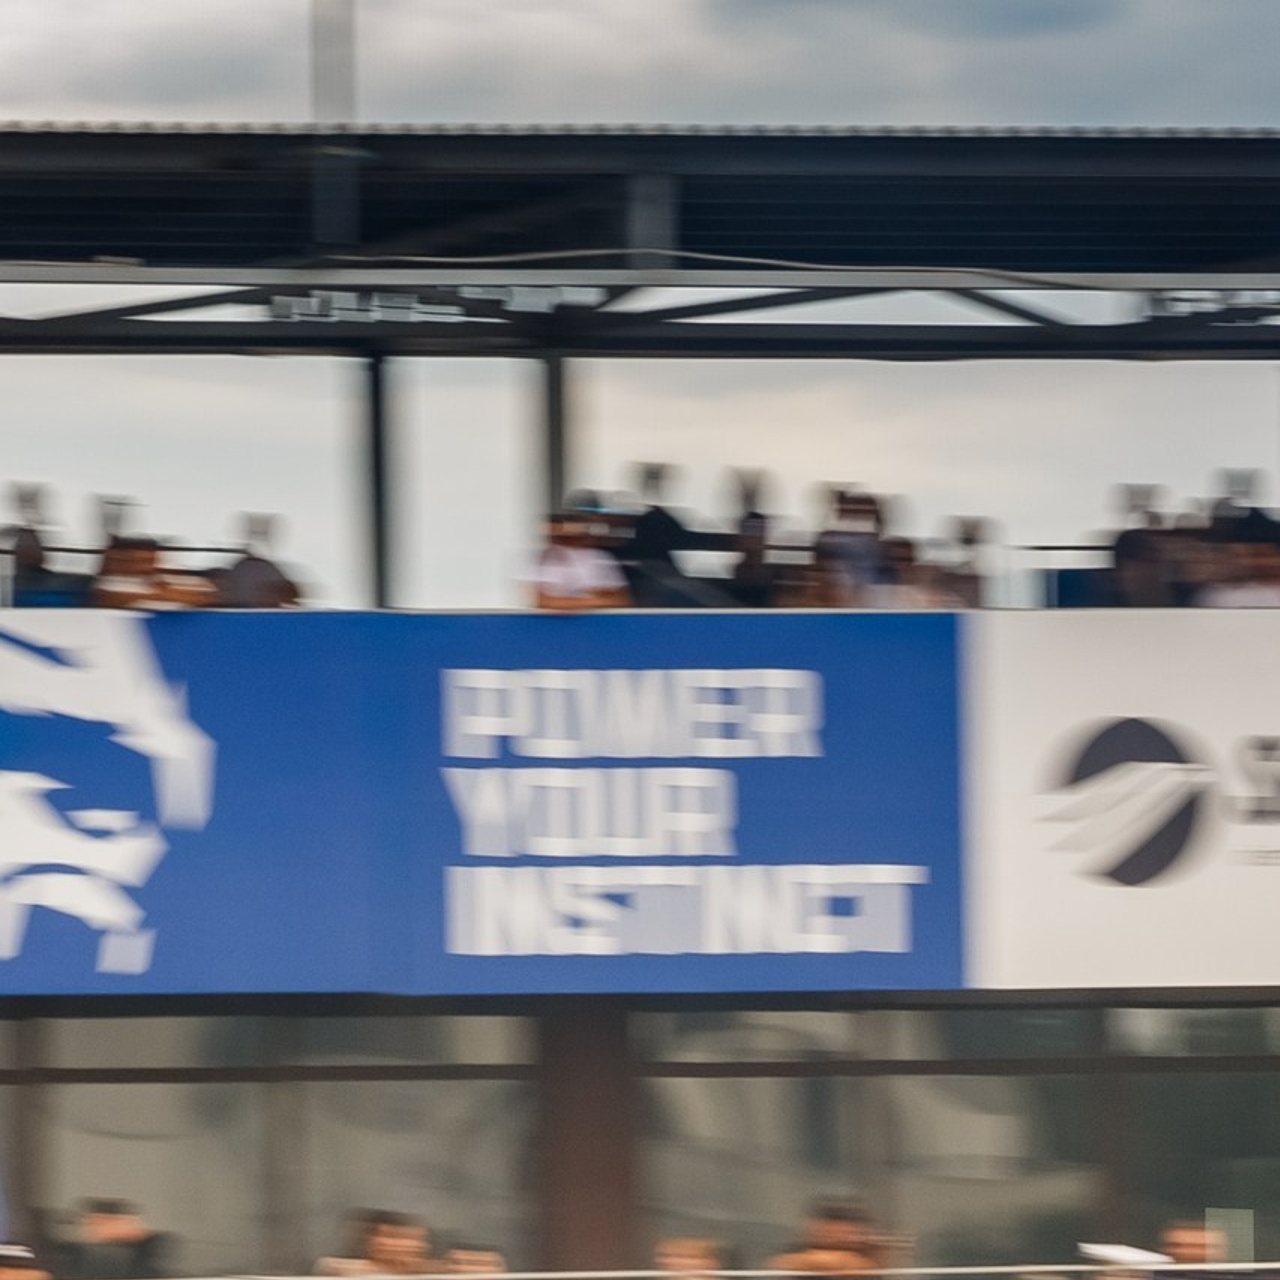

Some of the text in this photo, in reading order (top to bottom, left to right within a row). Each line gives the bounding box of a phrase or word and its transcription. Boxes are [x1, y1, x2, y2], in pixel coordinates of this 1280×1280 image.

[440, 668, 824, 758] POWER
[440, 767, 739, 857] YOUR
[444, 864, 928, 956] INSTINCT
